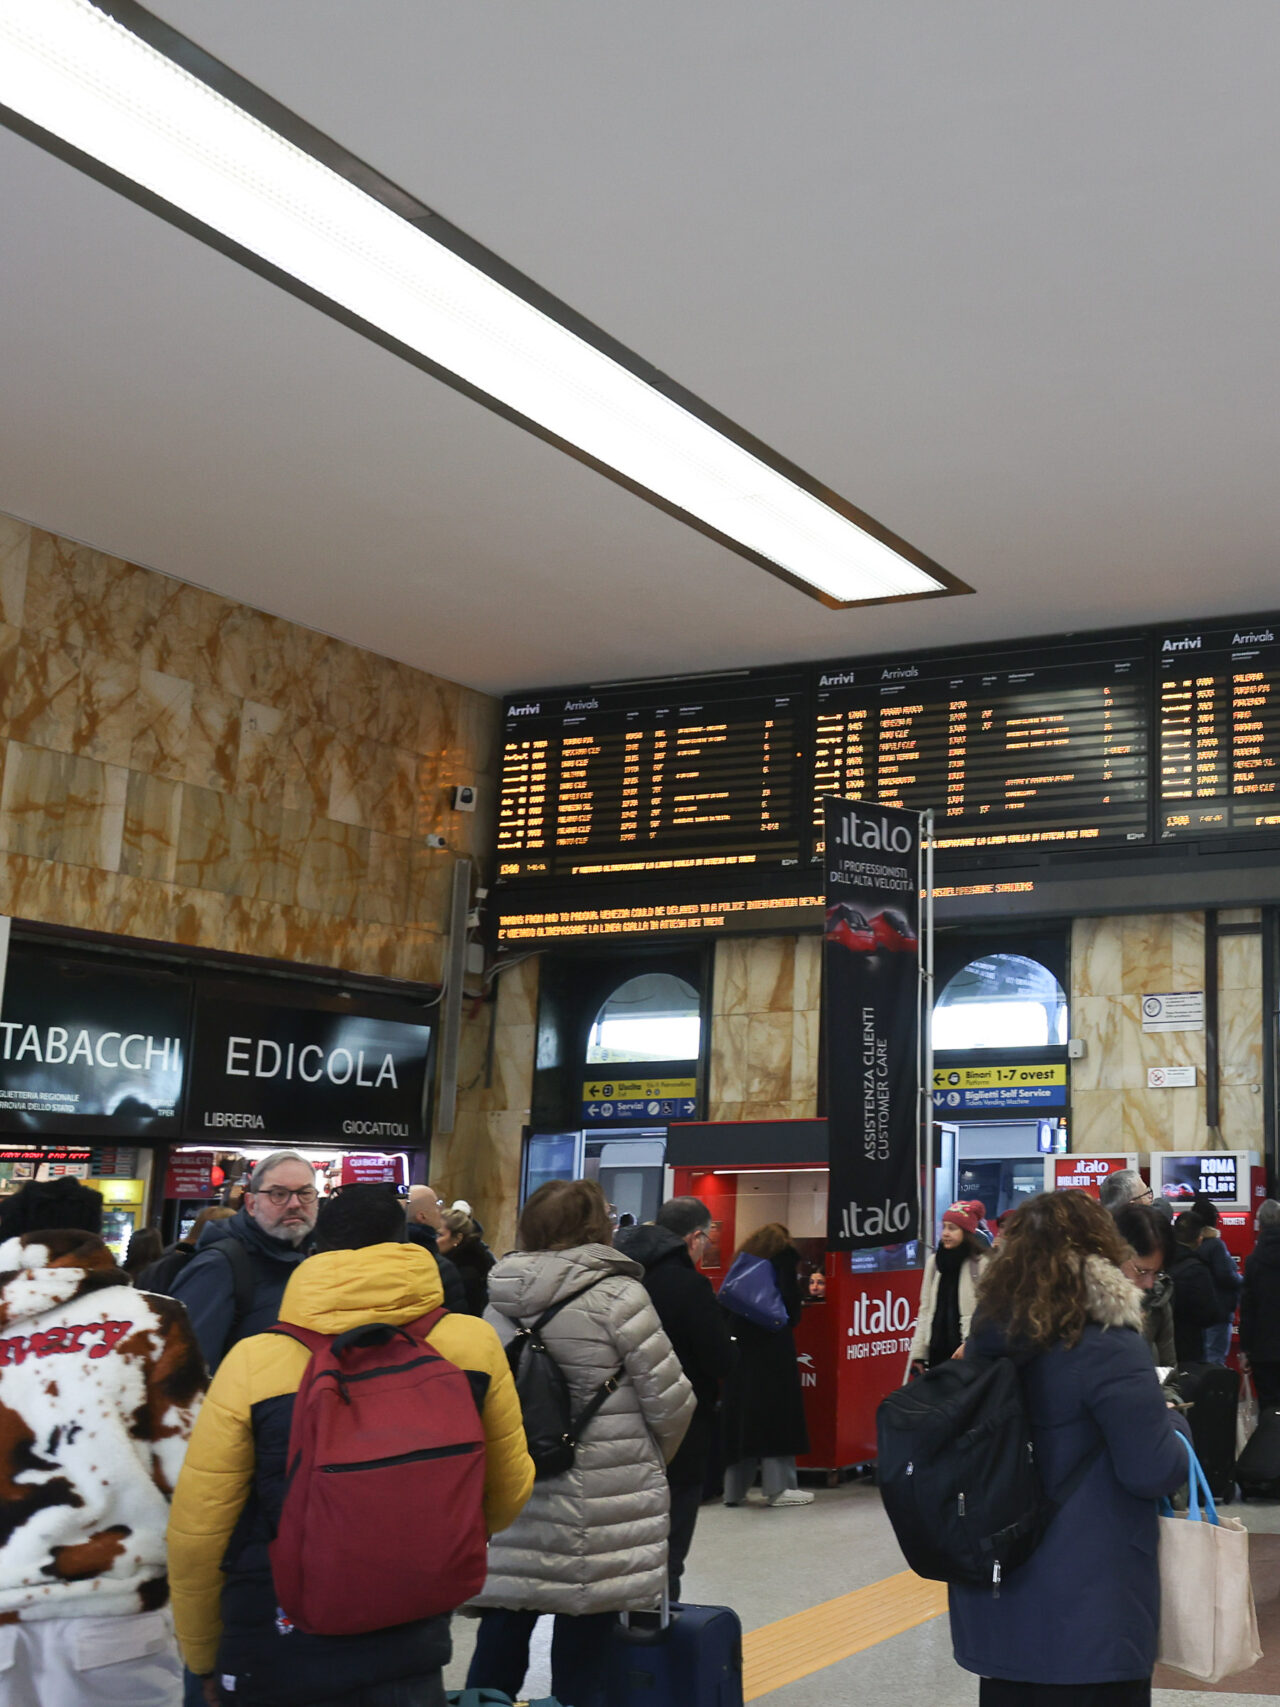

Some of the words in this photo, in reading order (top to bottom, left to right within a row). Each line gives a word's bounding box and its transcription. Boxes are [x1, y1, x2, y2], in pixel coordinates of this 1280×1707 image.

[1162, 636, 1202, 652] Arrivi
[1232, 629, 1275, 645] Arrivals
[819, 672, 854, 686] Arrivi
[881, 666, 919, 680] Arrivals
[508, 704, 540, 717] Arrivi
[564, 699, 599, 711] Arrivals
[844, 860, 908, 879] PROFESSIONISTI
[830, 872, 873, 887] DELL'ALTA
[874, 878, 914, 892] VELOCITÀ
[862, 1006, 875, 1067] CLIENTI
[0, 1022, 181, 1072] TABACCHI
[226, 1036, 399, 1090] EDICOLA
[876, 1038, 888, 1078] CARE
[966, 1071, 992, 1079] Binari
[997, 1070, 1017, 1081] 1-7
[1020, 1070, 1055, 1080] ovest
[39, 1092, 80, 1102] REGIONALE
[965, 1091, 999, 1101] Biglietti
[1000, 1090, 1018, 1098] Self
[1019, 1088, 1051, 1098] Service
[28, 1103, 52, 1111] DELLO
[618, 1102, 644, 1110] Servizi
[864, 1069, 876, 1161] ASSISTENZA
[204, 1112, 265, 1129] LIBRERIA
[343, 1120, 409, 1136] GIOCATTOLI
[877, 1081, 890, 1161] CUSTOMER
[1200, 1158, 1235, 1174] ROMA
[1056, 1176, 1091, 1187] BIGLIETTI
[847, 1343, 870, 1360] HIGH
[871, 1339, 898, 1356] SPEED
